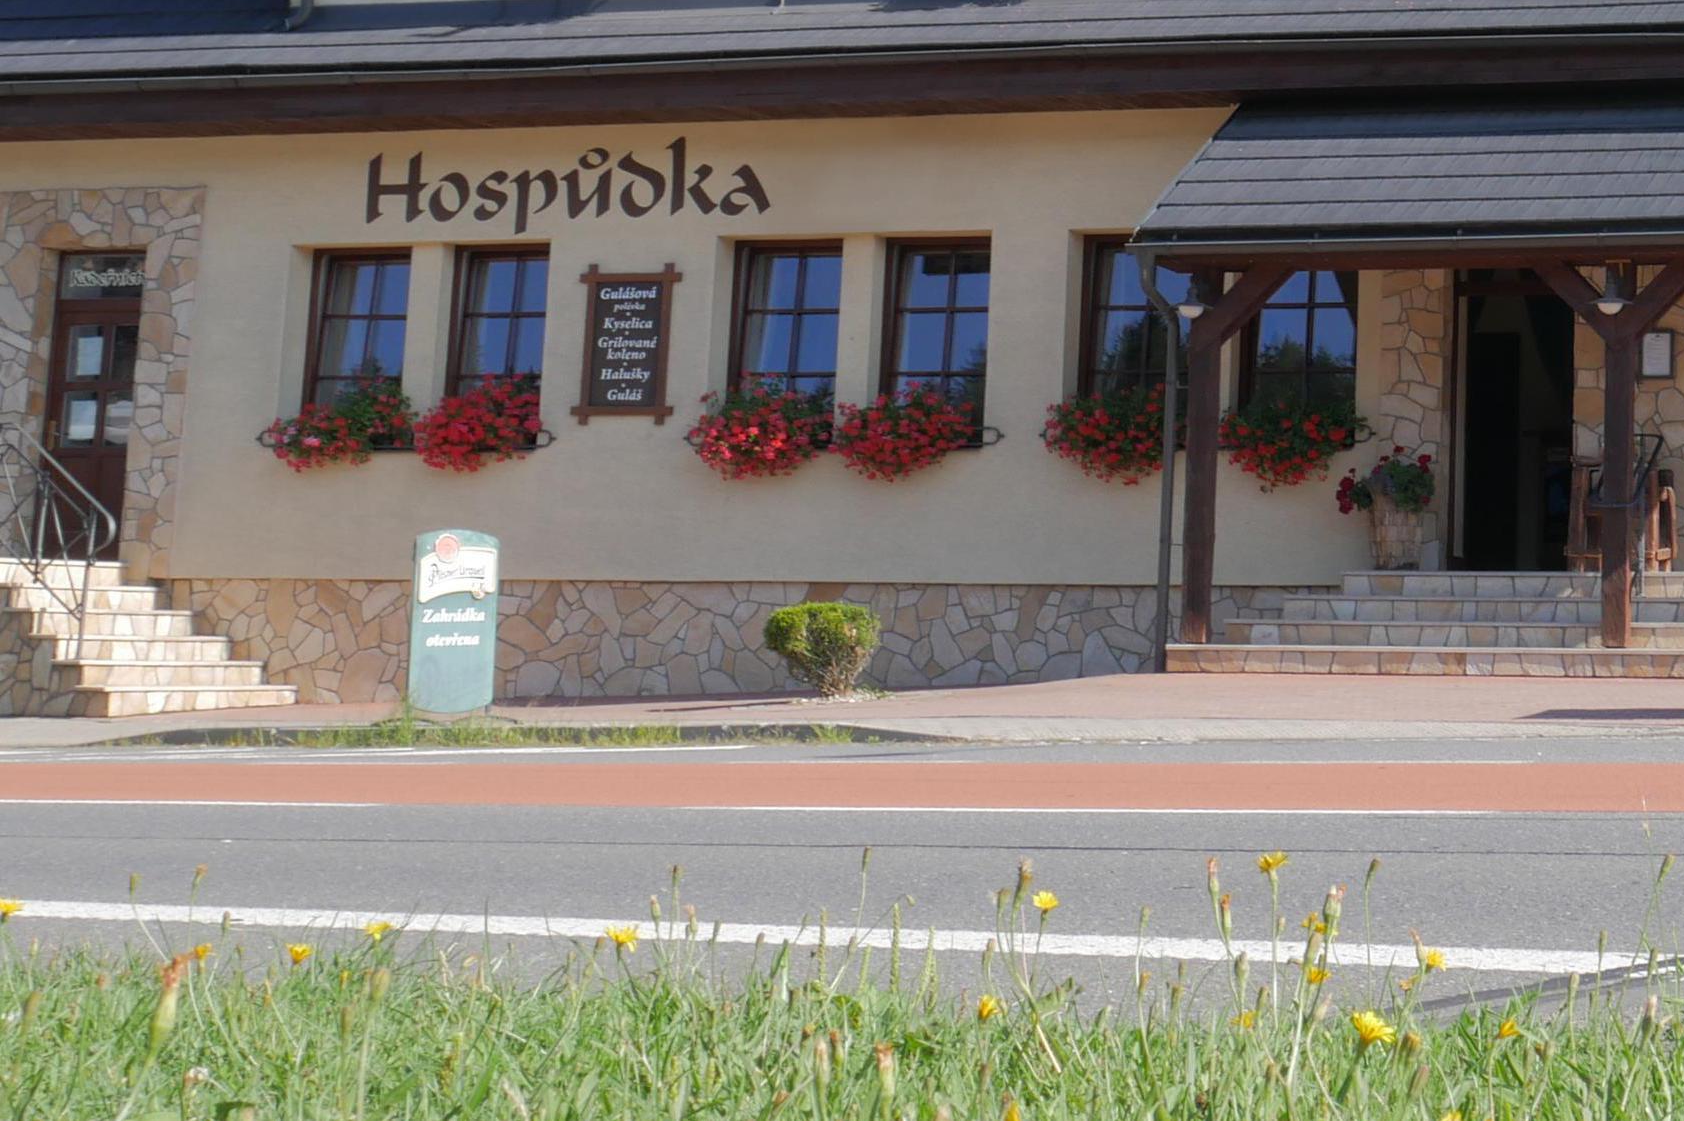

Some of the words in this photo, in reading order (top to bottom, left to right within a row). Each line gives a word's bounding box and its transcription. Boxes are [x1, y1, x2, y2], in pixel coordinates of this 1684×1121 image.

[366, 136, 771, 234] Hospůdka
[600, 286, 657, 300] Gulášová
[603, 317, 653, 333] Kyselica
[597, 335, 657, 349] Grilované
[606, 348, 646, 360] koleno
[600, 368, 650, 383] Halušky
[607, 388, 643, 401] Guláš
[422, 608, 486, 624] Zahrádka
